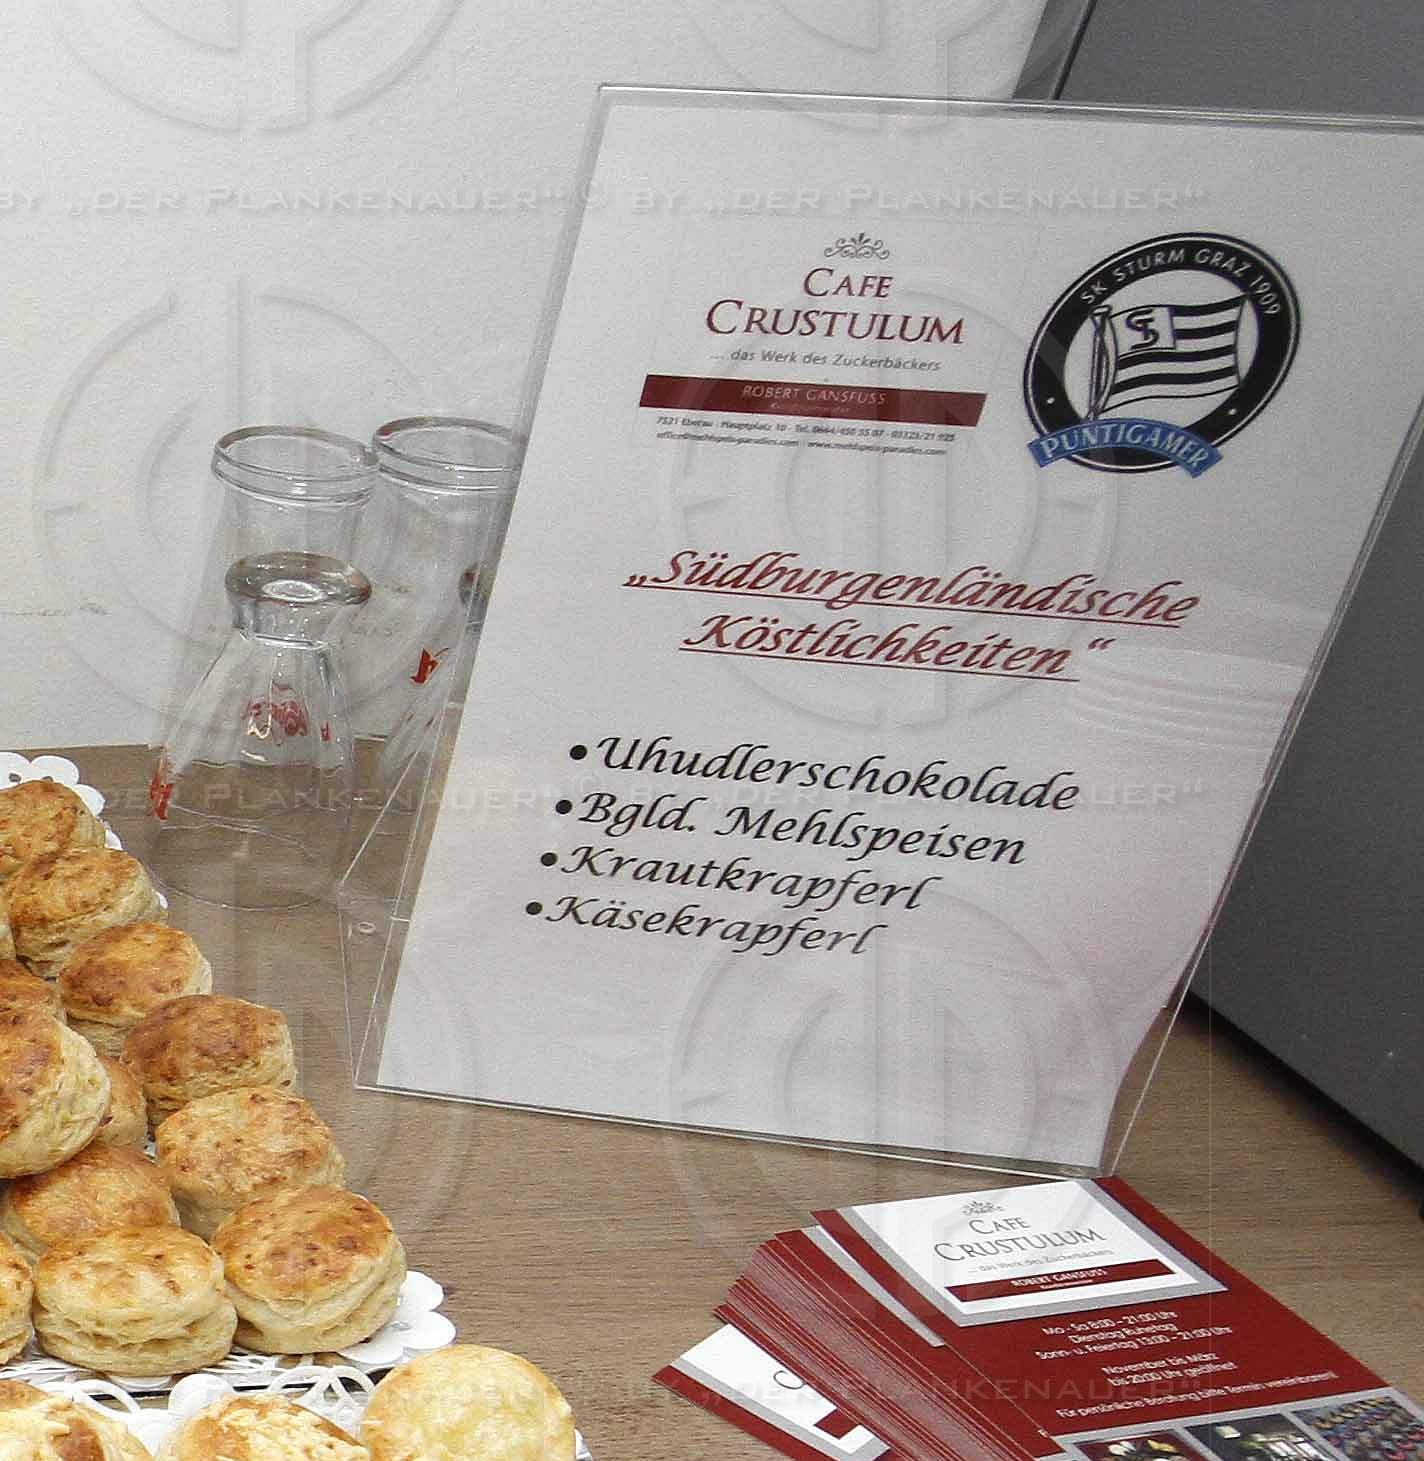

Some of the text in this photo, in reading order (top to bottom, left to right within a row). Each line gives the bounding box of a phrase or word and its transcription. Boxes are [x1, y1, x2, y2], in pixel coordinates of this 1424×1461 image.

[1081, 248, 1280, 315] SK STURM GRAZ 1909
[731, 349, 755, 362] das
[760, 349, 799, 364] Werk
[803, 351, 828, 366] des
[741, 385, 800, 402] ROBERT
[1041, 423, 1210, 466] PUNTIGAMER
[625, 549, 1202, 624] „Südburgenländische
[597, 735, 1082, 812] Uhudlerschokolade
[578, 790, 1027, 865] Bgld. Mehlspeisen
[560, 844, 945, 912] Krautkrapferl
[545, 894, 890, 957] Käsekrapferl
